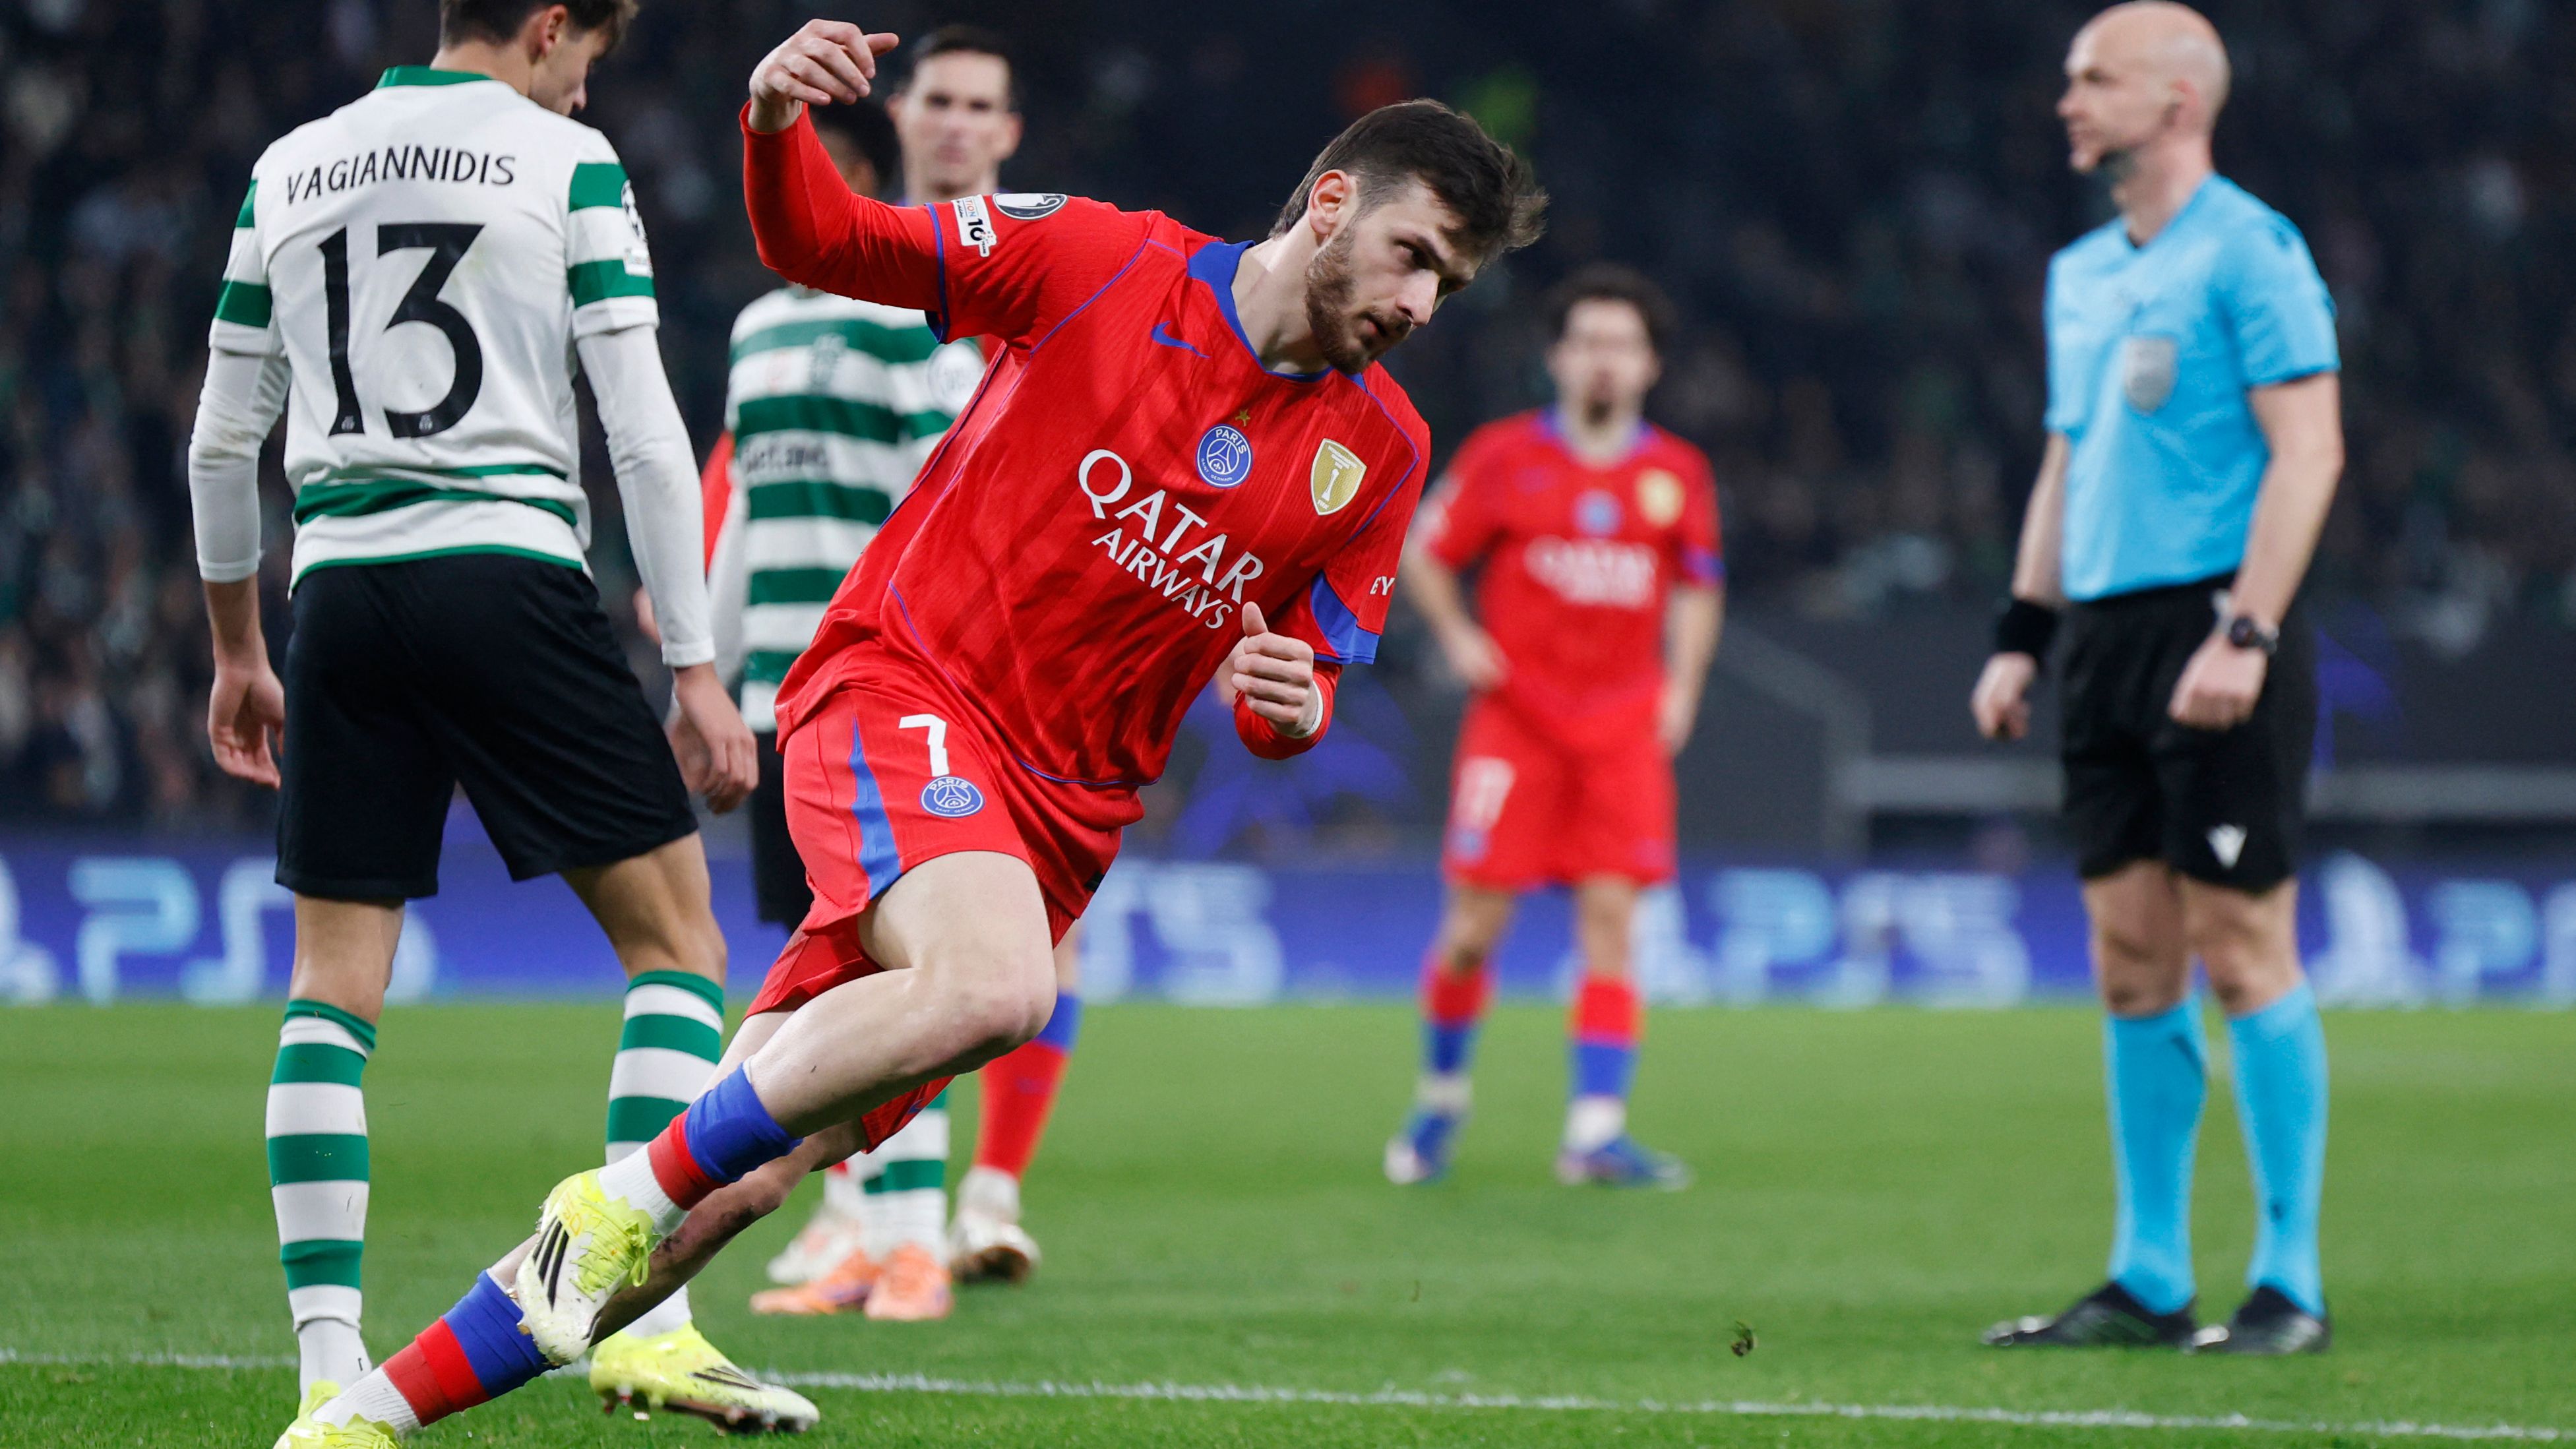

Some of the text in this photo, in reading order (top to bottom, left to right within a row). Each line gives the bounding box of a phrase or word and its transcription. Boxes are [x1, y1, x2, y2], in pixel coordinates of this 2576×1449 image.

[287, 144, 516, 206] VAGIANNIDIS
[317, 221, 487, 439] 13
[1215, 428, 1247, 454] PARIS
[1078, 448, 1264, 605] QATAR
[1091, 527, 1234, 629] AIRWAYS
[898, 713, 950, 777] 7
[929, 778, 969, 791] PARIS
